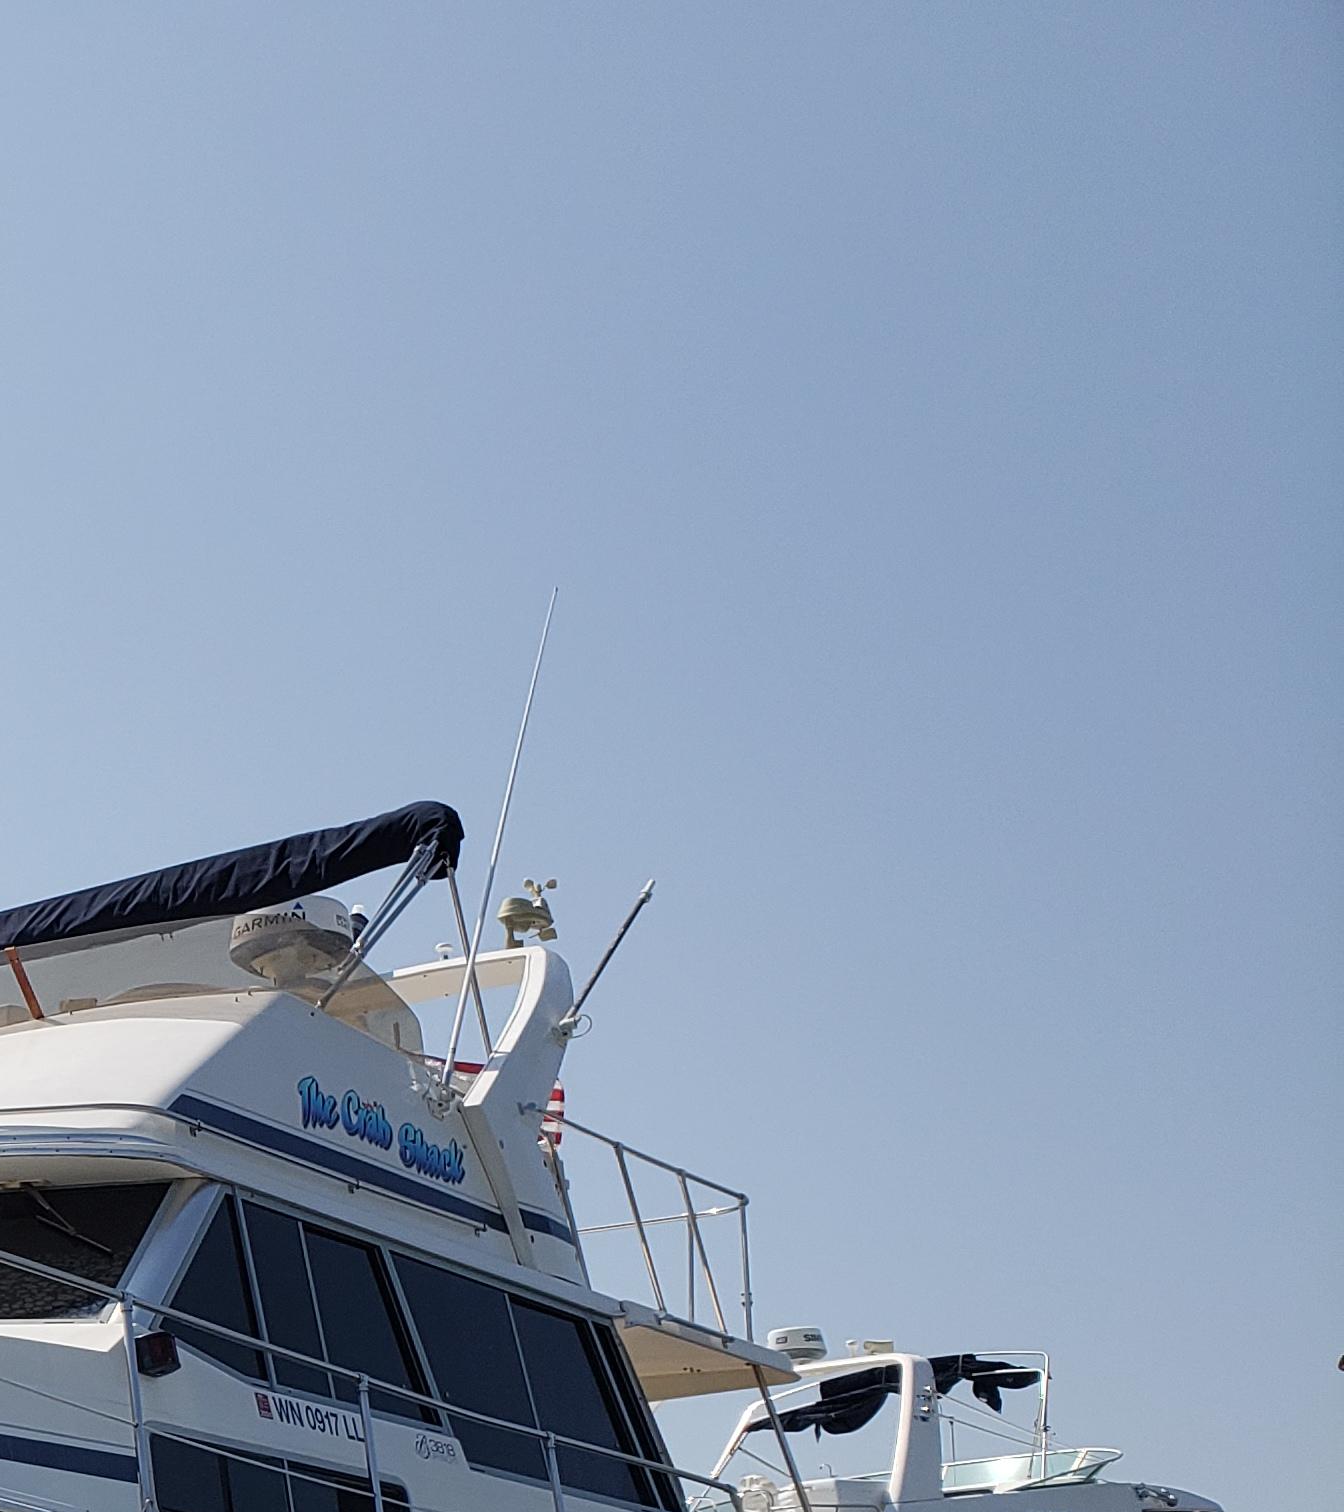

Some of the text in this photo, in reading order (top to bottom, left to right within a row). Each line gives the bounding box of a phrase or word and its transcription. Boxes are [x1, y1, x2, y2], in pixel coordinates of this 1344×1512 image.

[233, 911, 306, 940] GARMIN
[297, 1075, 465, 1185] The Crab Shack
[272, 1396, 305, 1428] WN
[305, 1405, 339, 1437] 0917
[342, 1414, 366, 1443] LL
